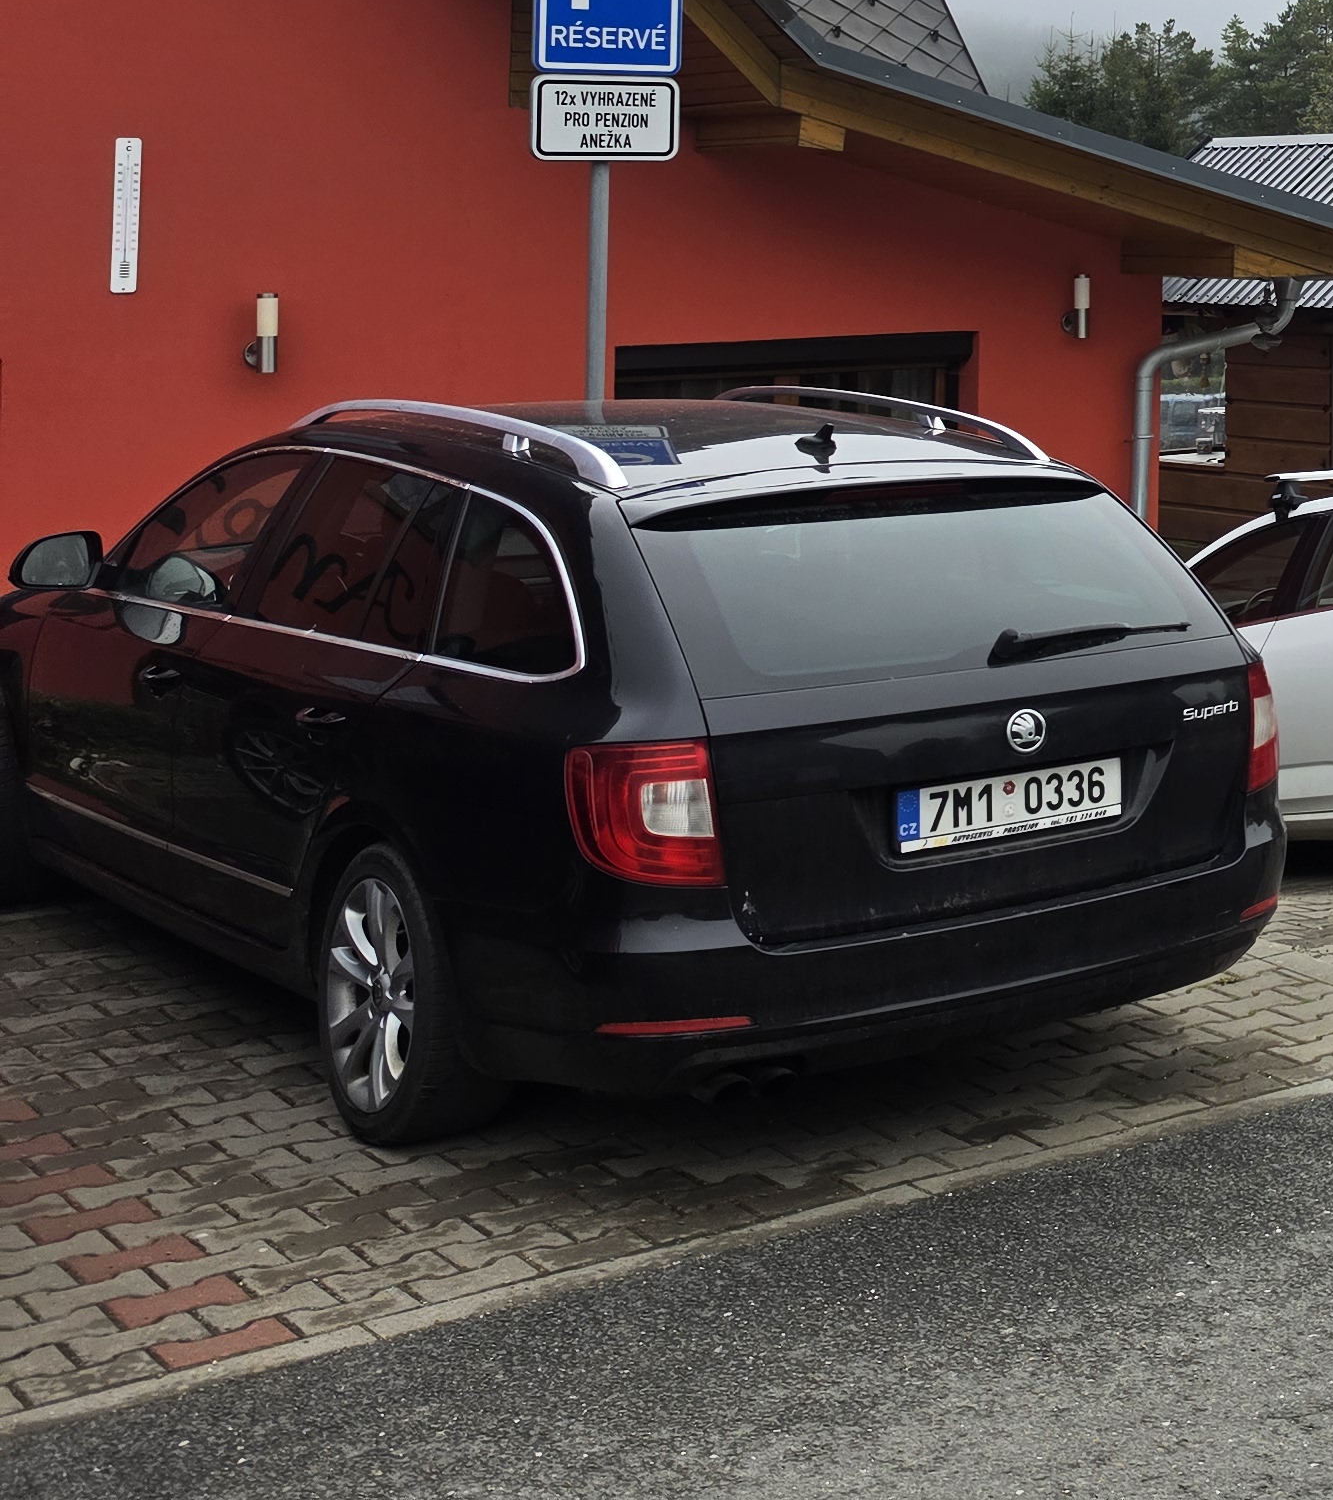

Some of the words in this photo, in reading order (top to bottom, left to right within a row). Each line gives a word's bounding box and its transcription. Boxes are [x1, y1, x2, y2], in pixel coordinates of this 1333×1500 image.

[551, 20, 667, 50] RÉSERVÉ
[555, 90, 577, 106] 12x
[580, 89, 657, 108] VYHRAZENÉ
[564, 111, 590, 127] PRO
[595, 112, 649, 129] PENZION
[580, 129, 632, 149] ANEŽKA
[1182, 699, 1239, 722] Superb
[929, 783, 993, 833] 7M1
[1024, 766, 1105, 815] 0336
[900, 822, 918, 837] CZ
[951, 829, 994, 843] AUTOSERVIS
